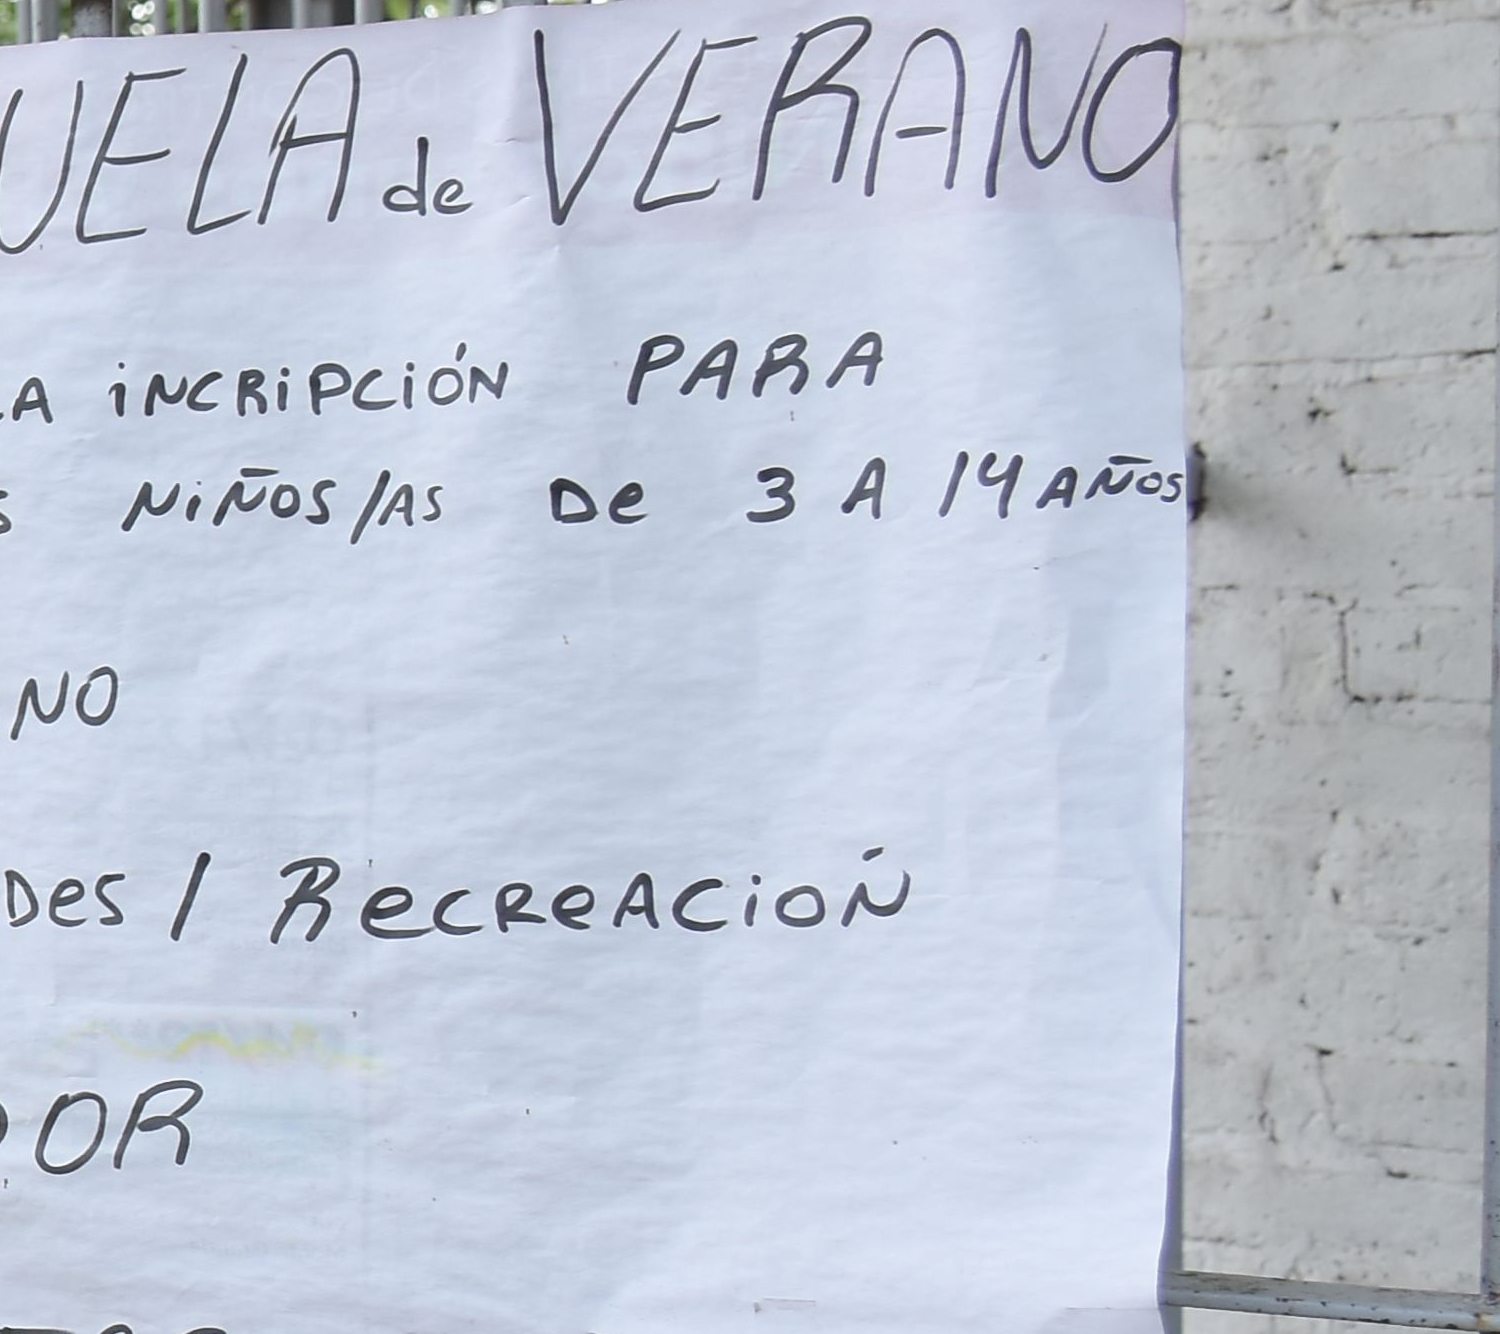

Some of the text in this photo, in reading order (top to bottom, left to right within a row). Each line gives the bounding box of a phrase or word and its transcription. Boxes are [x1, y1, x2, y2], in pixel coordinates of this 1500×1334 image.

[381, 135, 474, 218] de
[532, 15, 1185, 227] VERANO
[625, 330, 885, 407] PARA
[745, 465, 797, 525] 3
[839, 456, 887, 521] A
[1034, 454, 1185, 510] AÑOS
